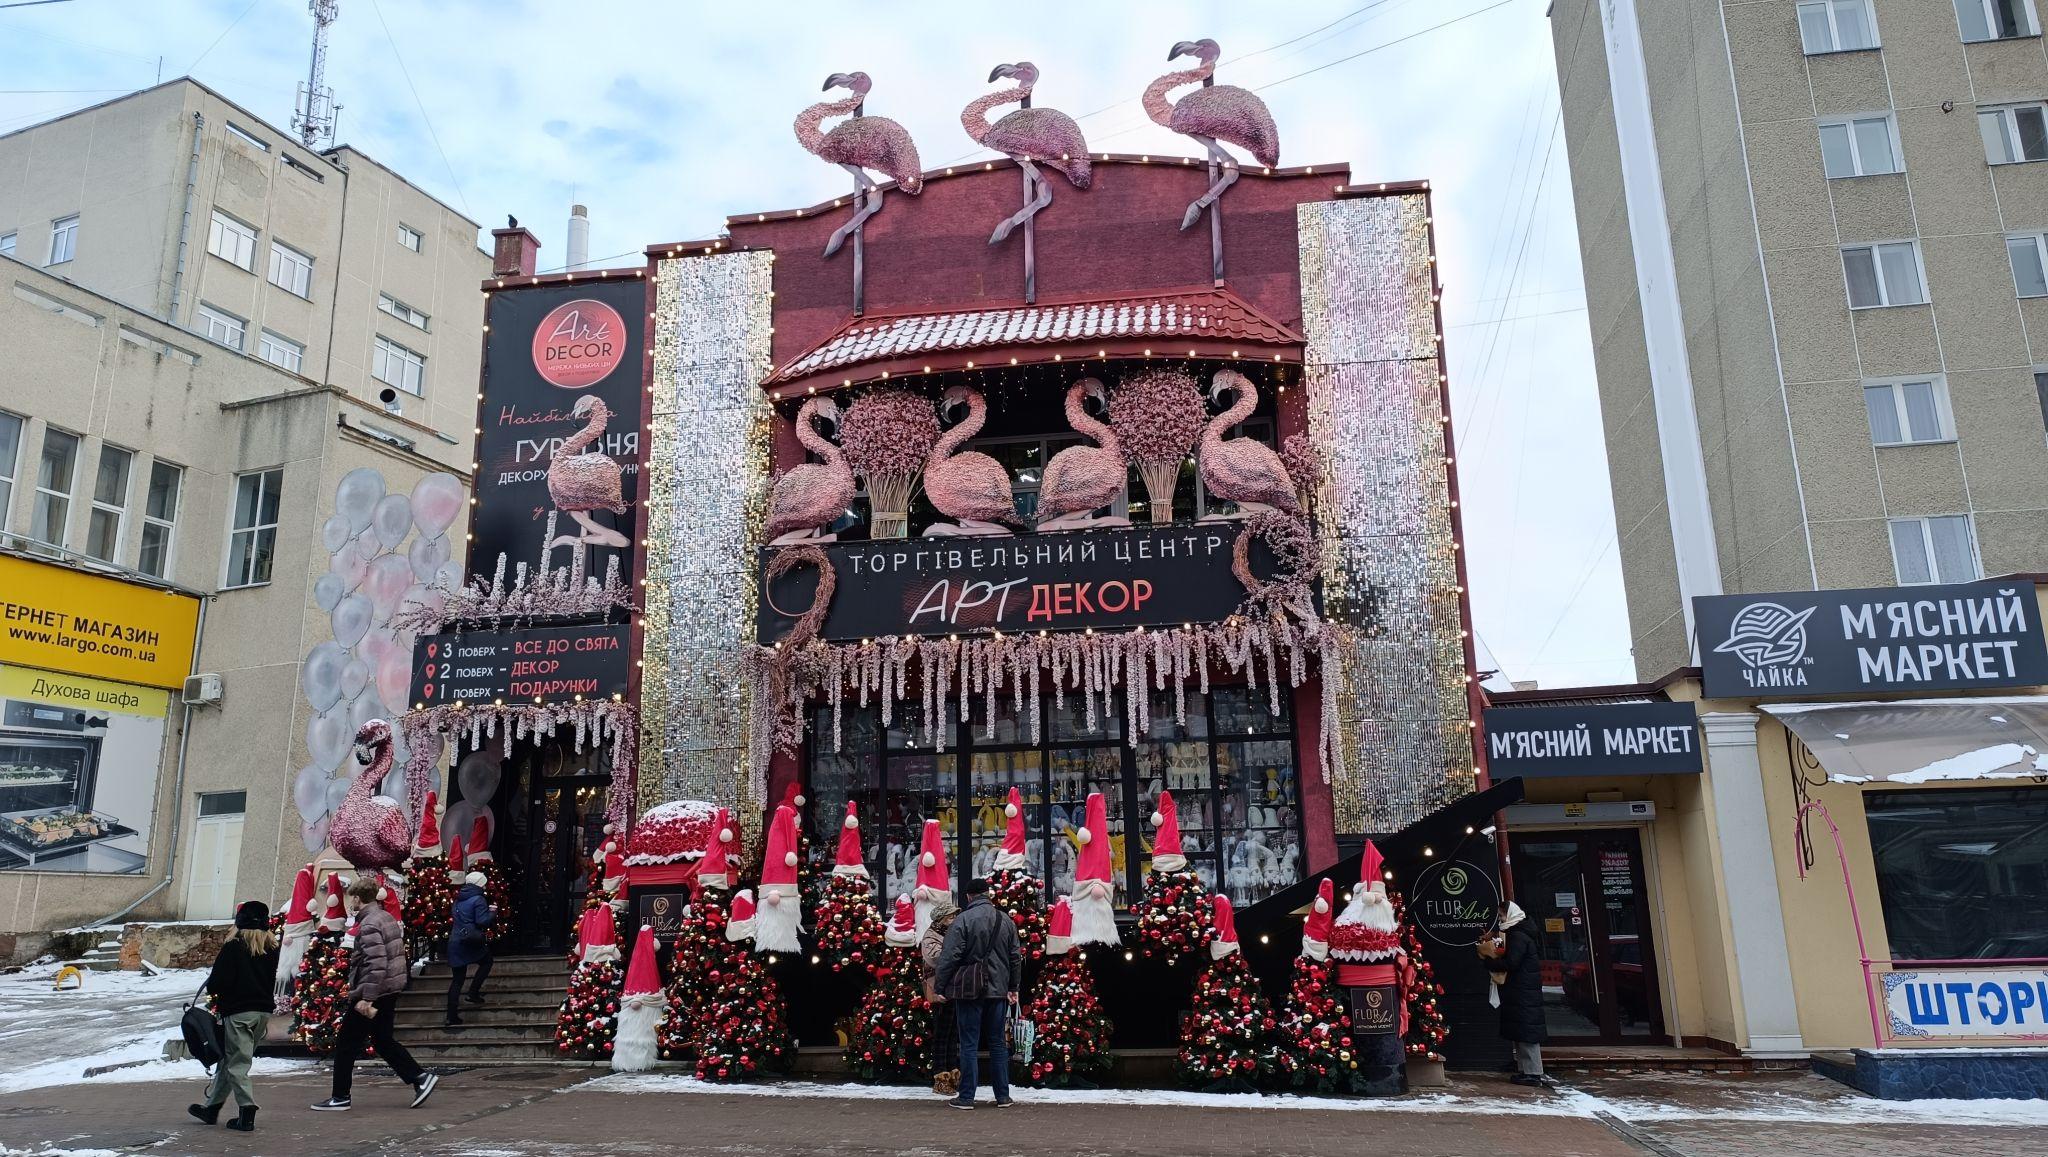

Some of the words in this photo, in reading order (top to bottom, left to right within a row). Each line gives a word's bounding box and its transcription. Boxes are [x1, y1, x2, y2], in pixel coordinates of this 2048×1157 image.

[548, 310, 610, 343] Art
[545, 342, 612, 361] DECOR
[849, 540, 1097, 575] ТОРГІВЕЛЬНИЙ
[1114, 536, 1222, 563] ЦЕНТР
[909, 576, 1029, 624] АРТ
[1027, 579, 1153, 623] ДЕКОР
[0, 602, 68, 629] ЕРНЕТ
[73, 616, 159, 647] МАГАЗИН
[9, 627, 156, 663] www.largo.com.ua
[442, 643, 452, 659] 3
[458, 647, 496, 658] ПОВЕРХ
[514, 640, 542, 655] ВСЕ
[546, 639, 569, 655] ДО
[575, 636, 619, 651] СВЯТА
[440, 663, 450, 679] 2
[456, 667, 494, 678] ПОВЕРХ
[511, 660, 560, 677] ДЕКОР
[1742, 665, 1808, 688] ЧАЙКА
[1857, 640, 2018, 684] МАРКЕТ
[31, 678, 91, 700] Духова
[96, 690, 139, 709] шафа
[440, 684, 445, 699] 1
[453, 687, 491, 699] ПОВЕРХ
[510, 678, 598, 697] ПОДАРУНКИ
[1603, 725, 1692, 756] МАРКЕТ
[1426, 900, 1461, 916] FLOR
